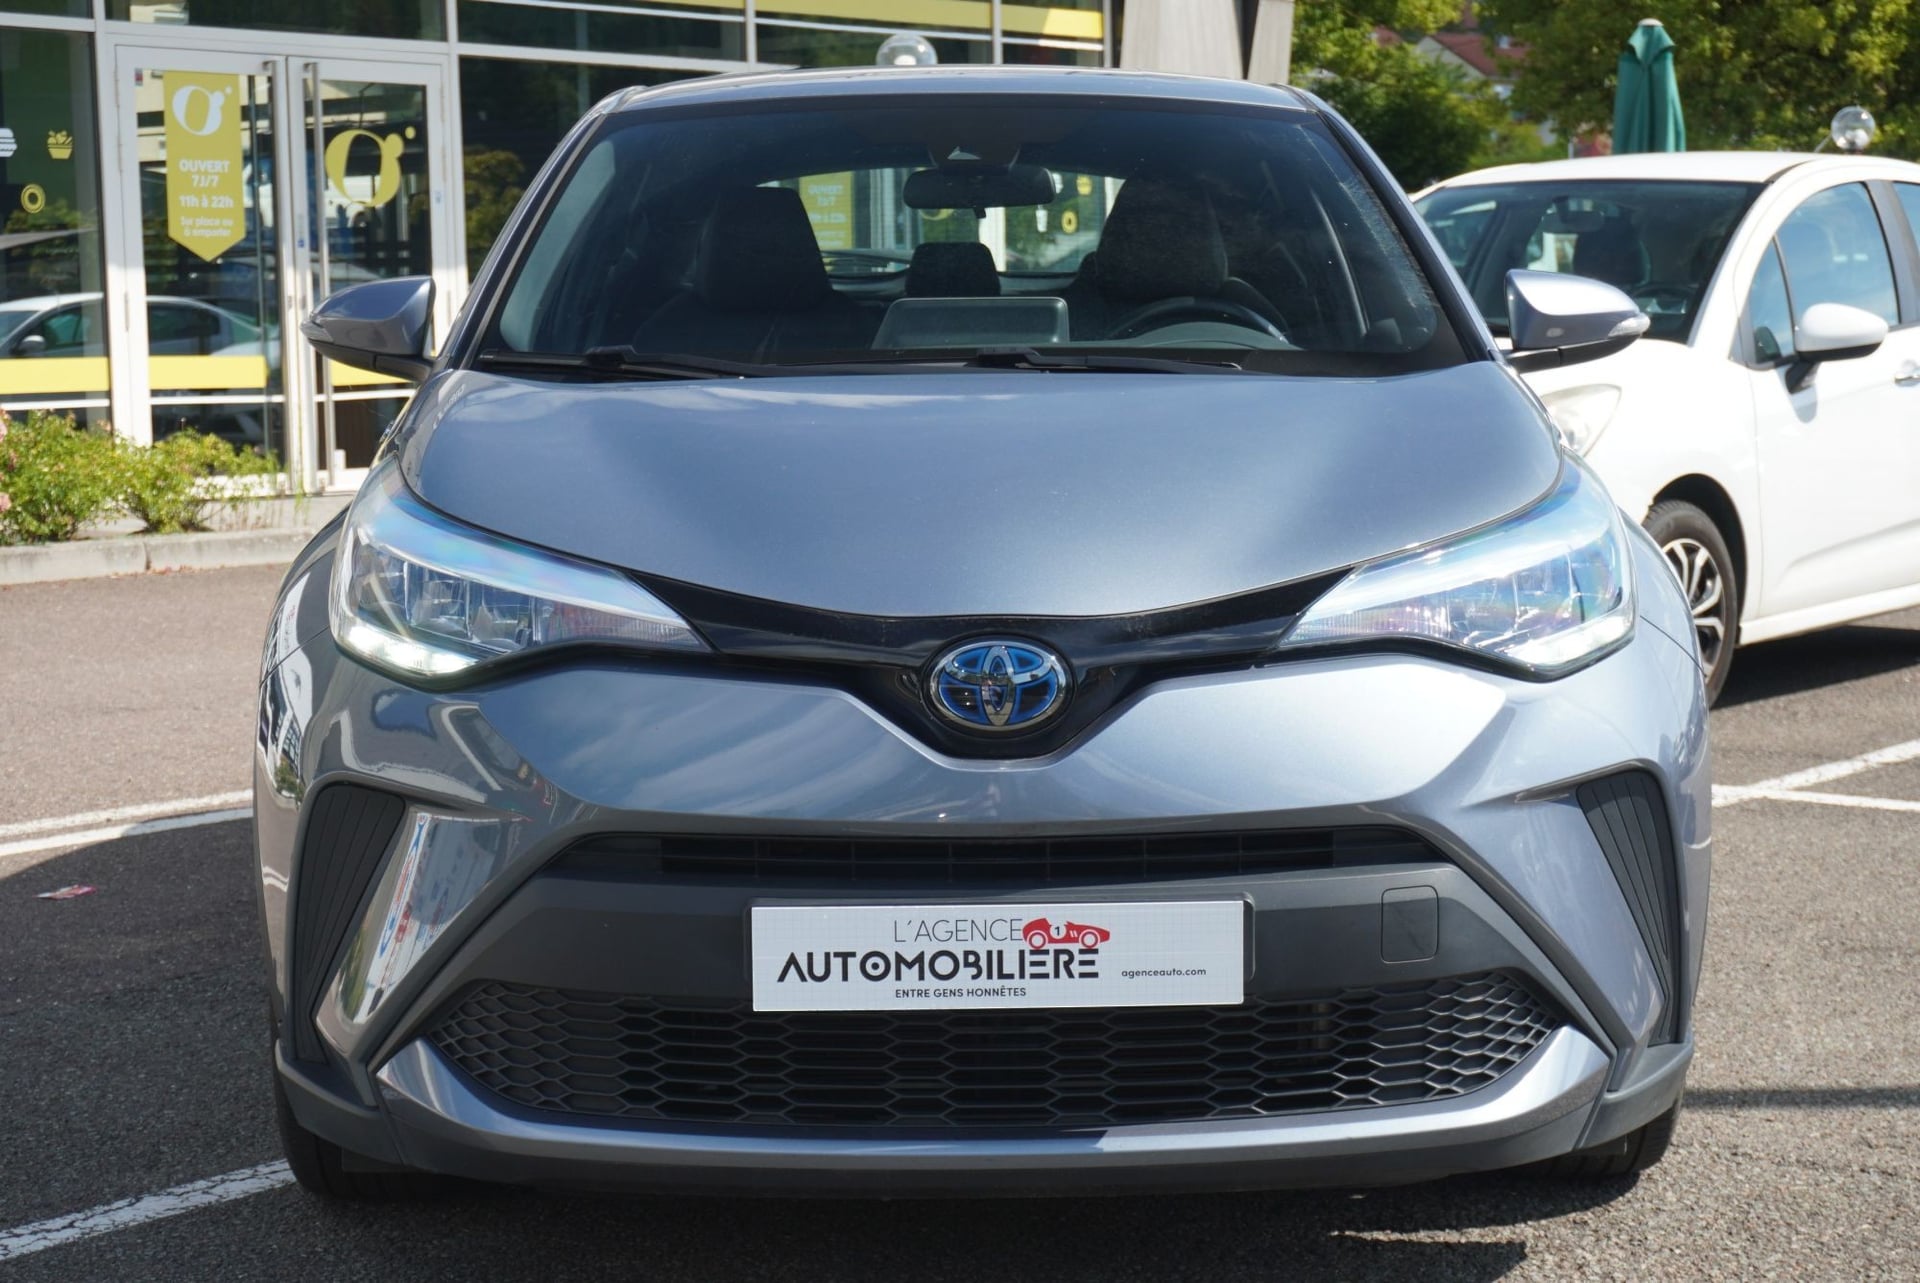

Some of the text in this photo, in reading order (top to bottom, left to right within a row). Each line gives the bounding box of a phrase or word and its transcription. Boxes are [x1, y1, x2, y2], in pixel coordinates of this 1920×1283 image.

[179, 159, 230, 173] OUVERT
[179, 194, 199, 208] 11h
[211, 195, 234, 208] 22h
[894, 918, 1061, 942] L'AGENCE 1
[1121, 968, 1206, 979] agenceauto.com
[895, 985, 1026, 998] ENTRE GENS HONNÊTES
